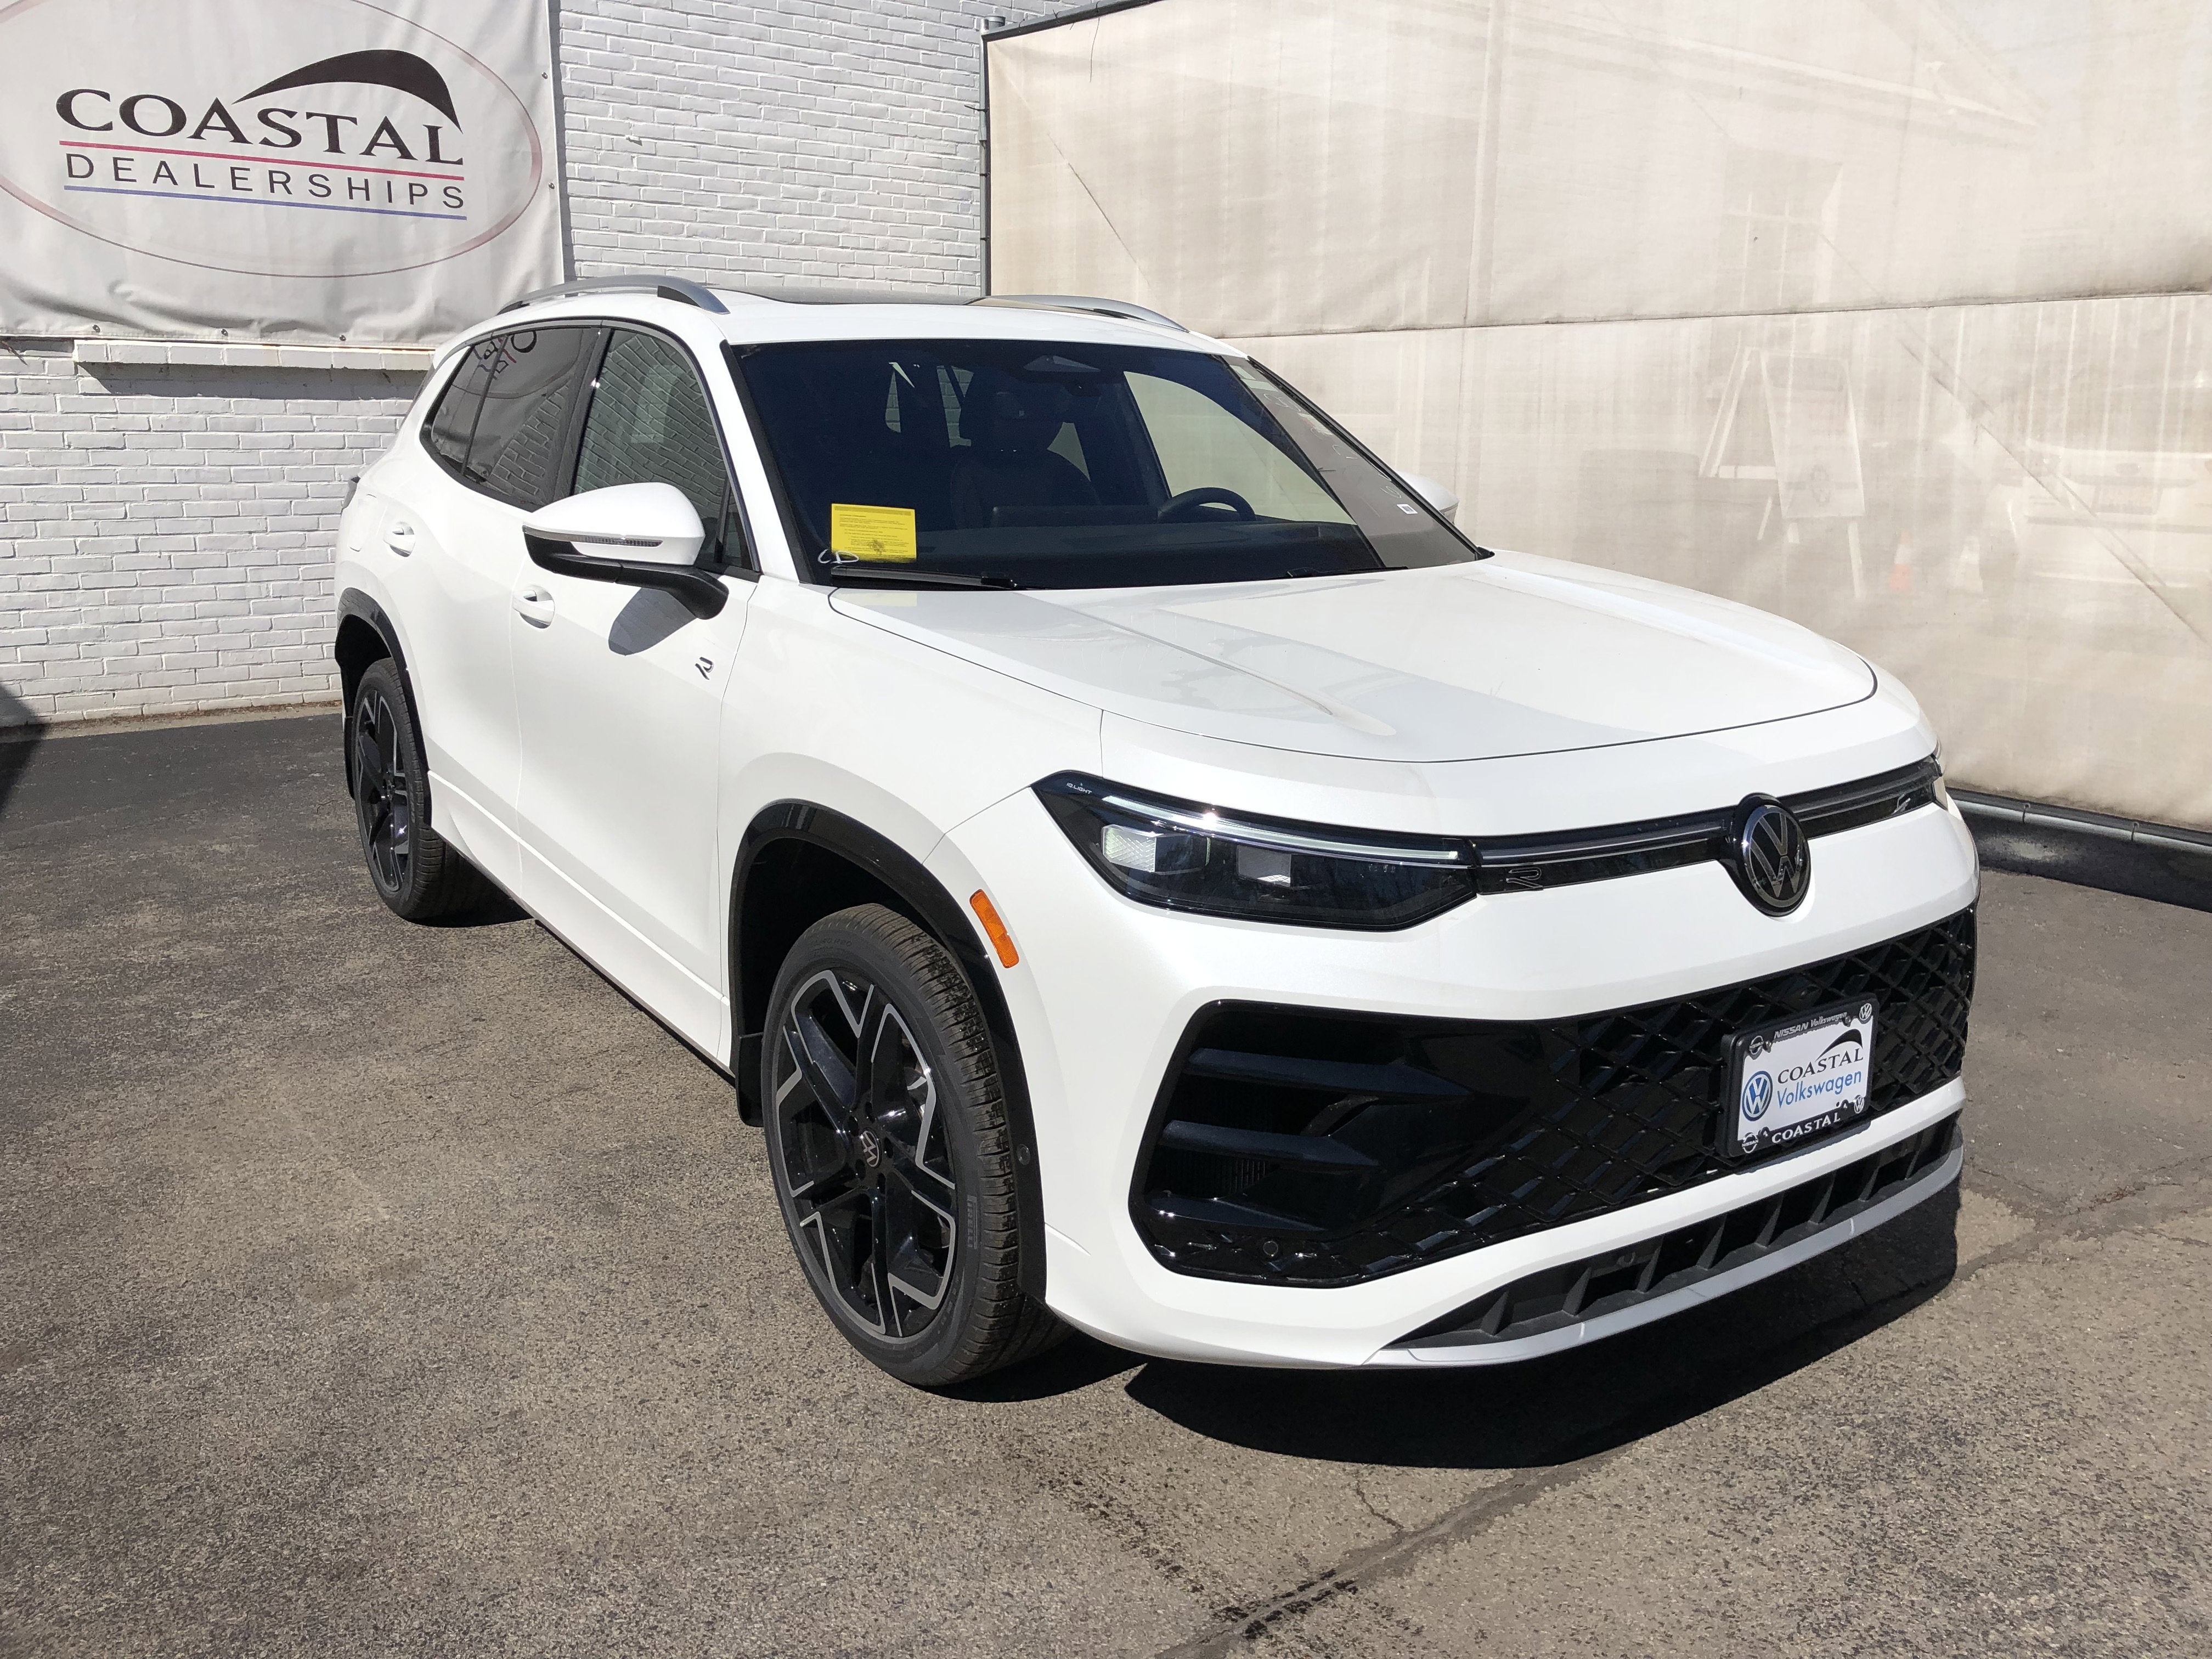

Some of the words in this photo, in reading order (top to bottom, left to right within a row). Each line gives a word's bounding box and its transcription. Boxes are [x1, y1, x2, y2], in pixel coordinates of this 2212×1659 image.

[55, 88, 464, 166] COASTAL
[65, 152, 465, 210] DEALERSHIPS
[1773, 1022, 1809, 1039] NISSAN
[1810, 1012, 1848, 1027] Volkswagen
[1777, 1048, 1864, 1084] COASTAL
[1777, 1070, 1862, 1109] Volkswagen
[1771, 1112, 1841, 1144] COASTAL
